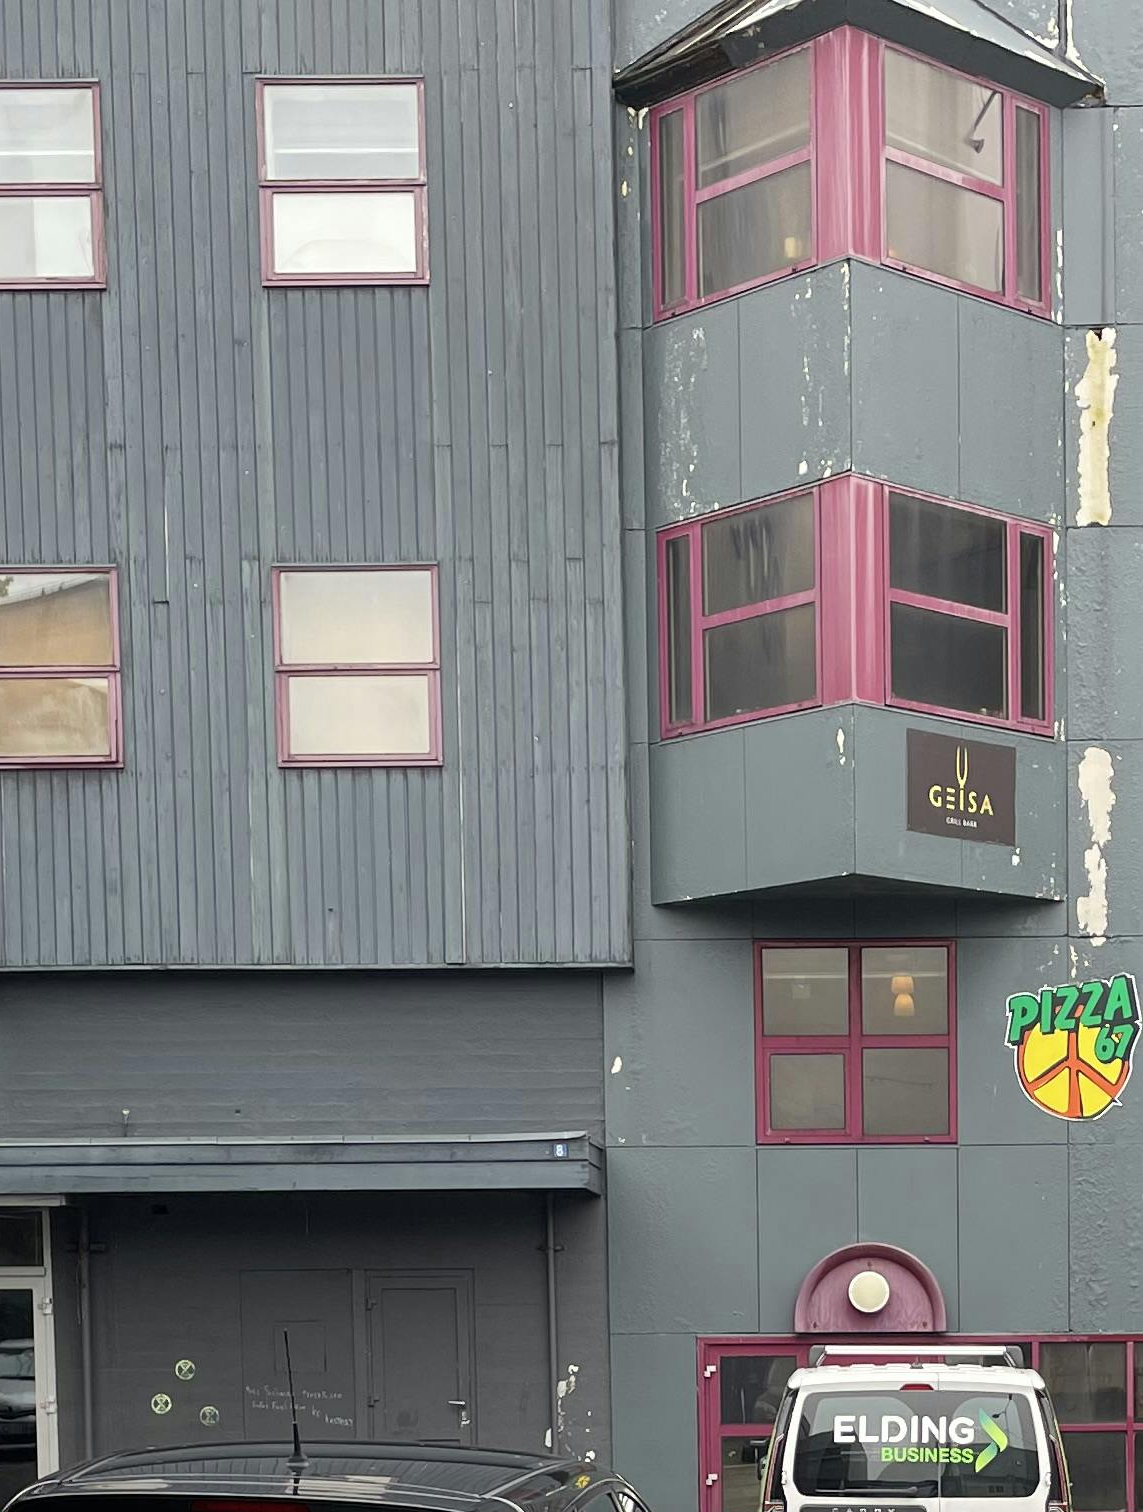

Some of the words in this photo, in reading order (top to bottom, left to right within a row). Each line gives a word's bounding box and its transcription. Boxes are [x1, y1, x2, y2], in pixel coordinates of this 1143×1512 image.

[928, 784, 994, 816] GEISA
[1009, 976, 1134, 1042] PIZZA
[1094, 1023, 1135, 1063] 67
[833, 1414, 975, 1445] ELDING
[881, 1447, 974, 1463] BUSINESS
